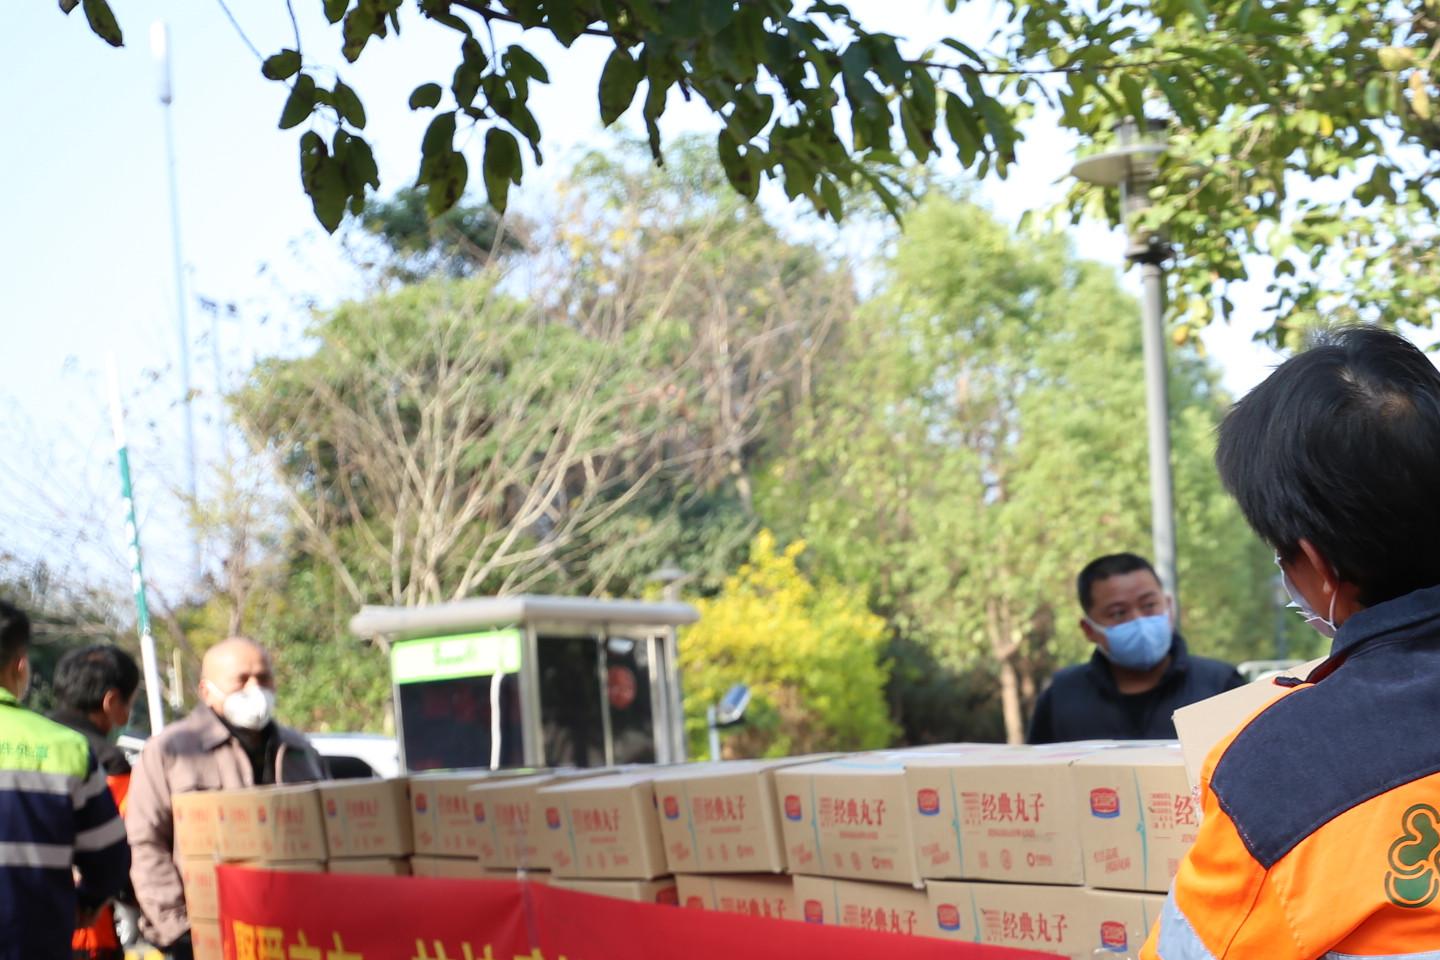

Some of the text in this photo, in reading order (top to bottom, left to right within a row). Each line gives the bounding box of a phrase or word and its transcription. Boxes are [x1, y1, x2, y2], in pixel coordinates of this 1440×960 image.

[834, 799, 886, 826] 经典丸子
[981, 793, 1045, 823] 经典丸子
[1002, 912, 1068, 943] 经典丸子
